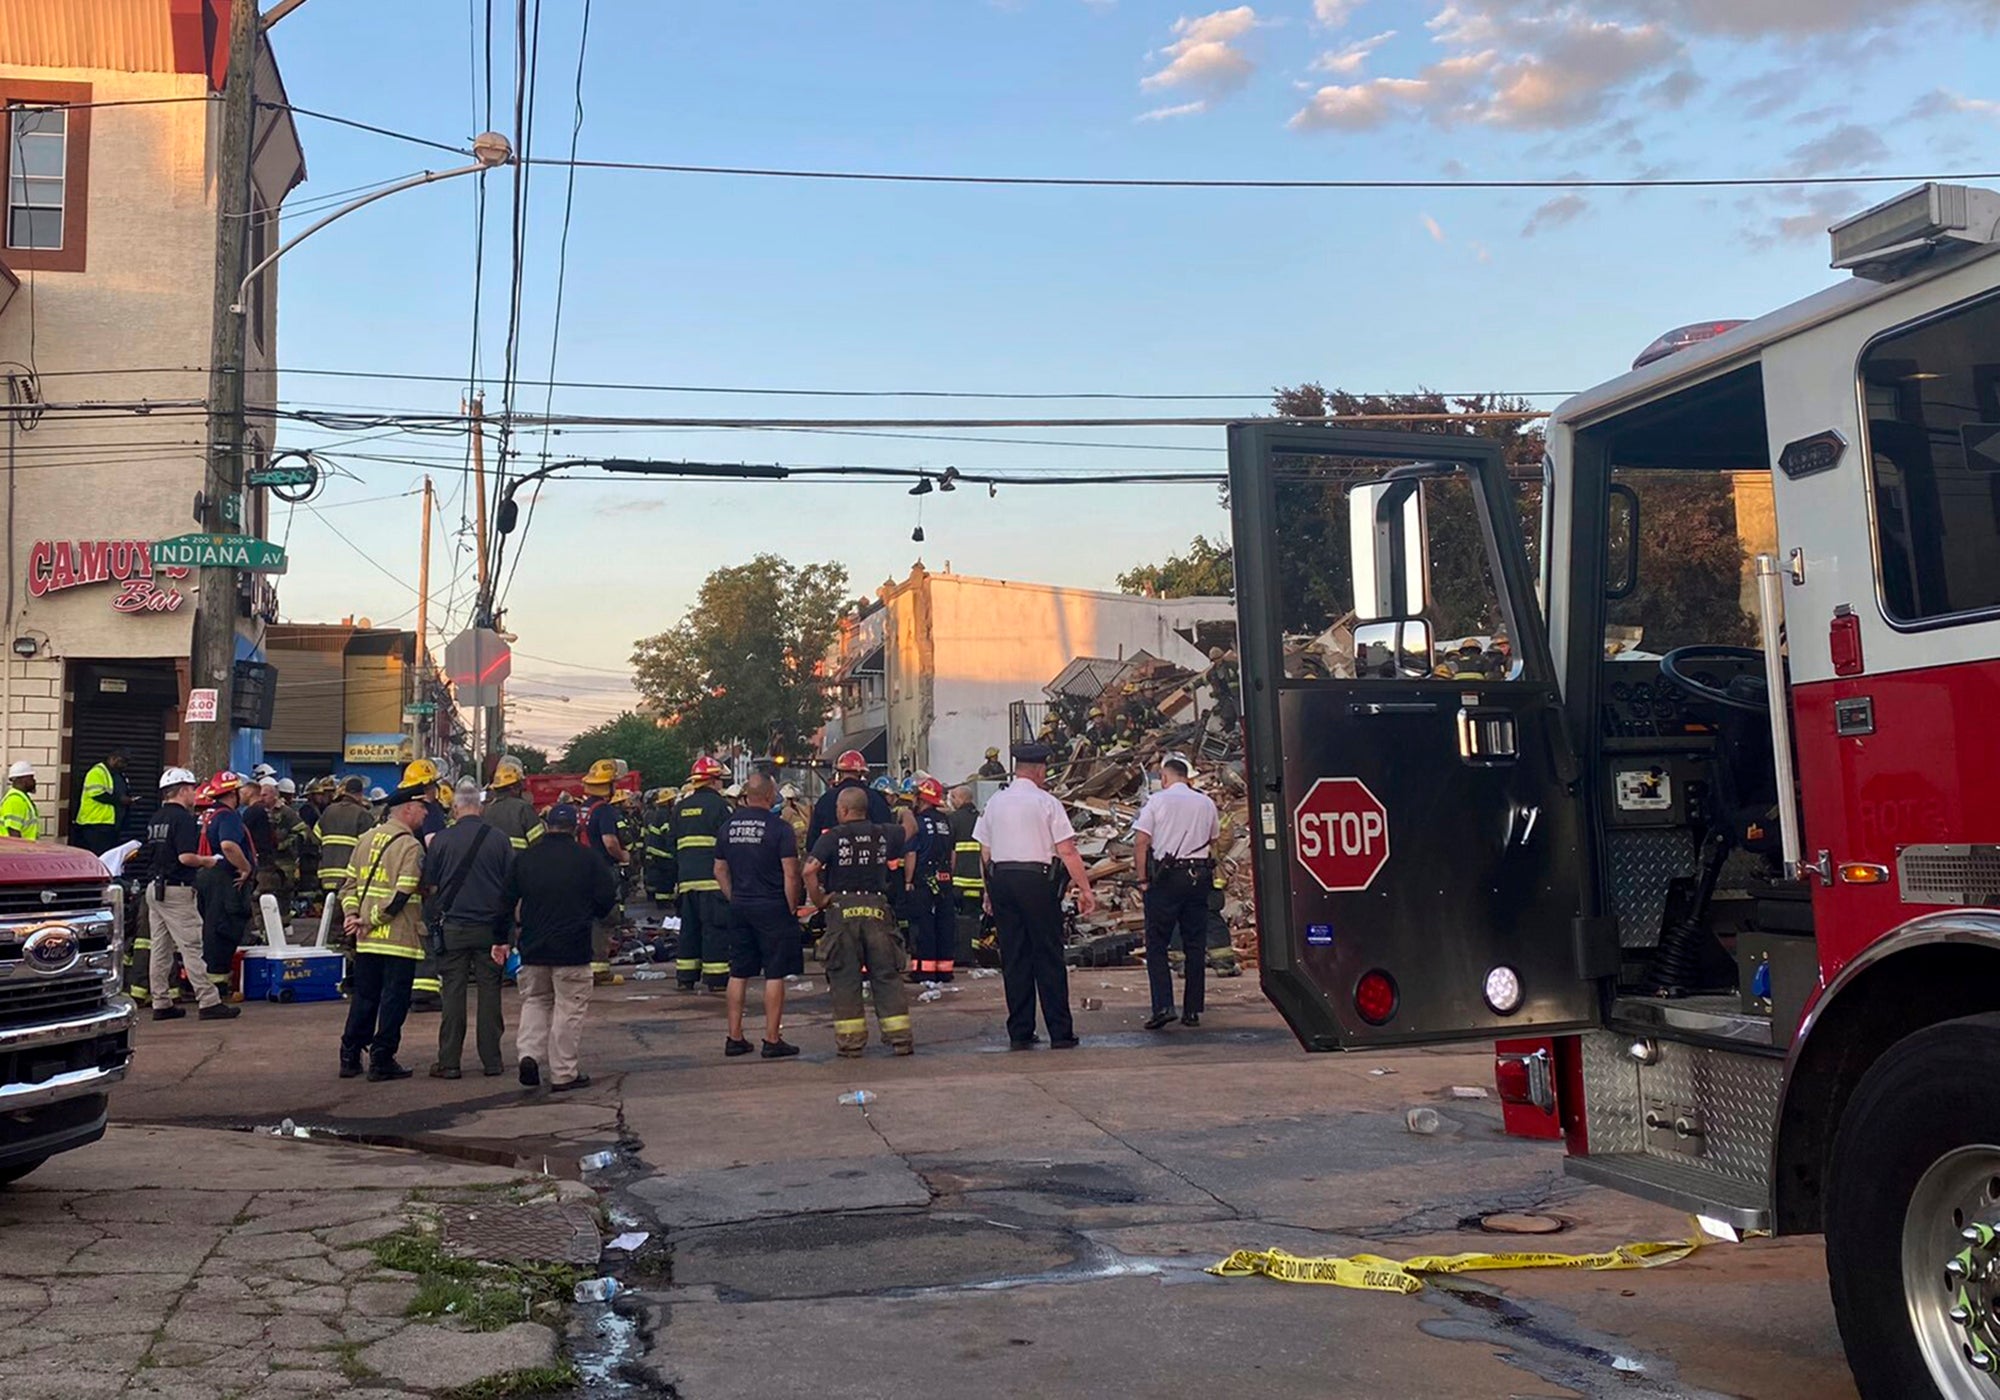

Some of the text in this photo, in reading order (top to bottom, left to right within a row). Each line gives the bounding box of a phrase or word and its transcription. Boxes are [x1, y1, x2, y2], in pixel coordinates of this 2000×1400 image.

[213, 537, 223, 545] W
[154, 545, 282, 564] INDIANA AV
[28, 539, 190, 598] CAMUY
[111, 579, 184, 613] Bar
[736, 827, 757, 836] FIRE
[1300, 811, 1382, 857] STOP
[42, 938, 69, 958] Ford
[1312, 1262, 1337, 1281] CROSS
[1363, 1270, 1389, 1287] POLICE
[1387, 1271, 1408, 1289] LINE
